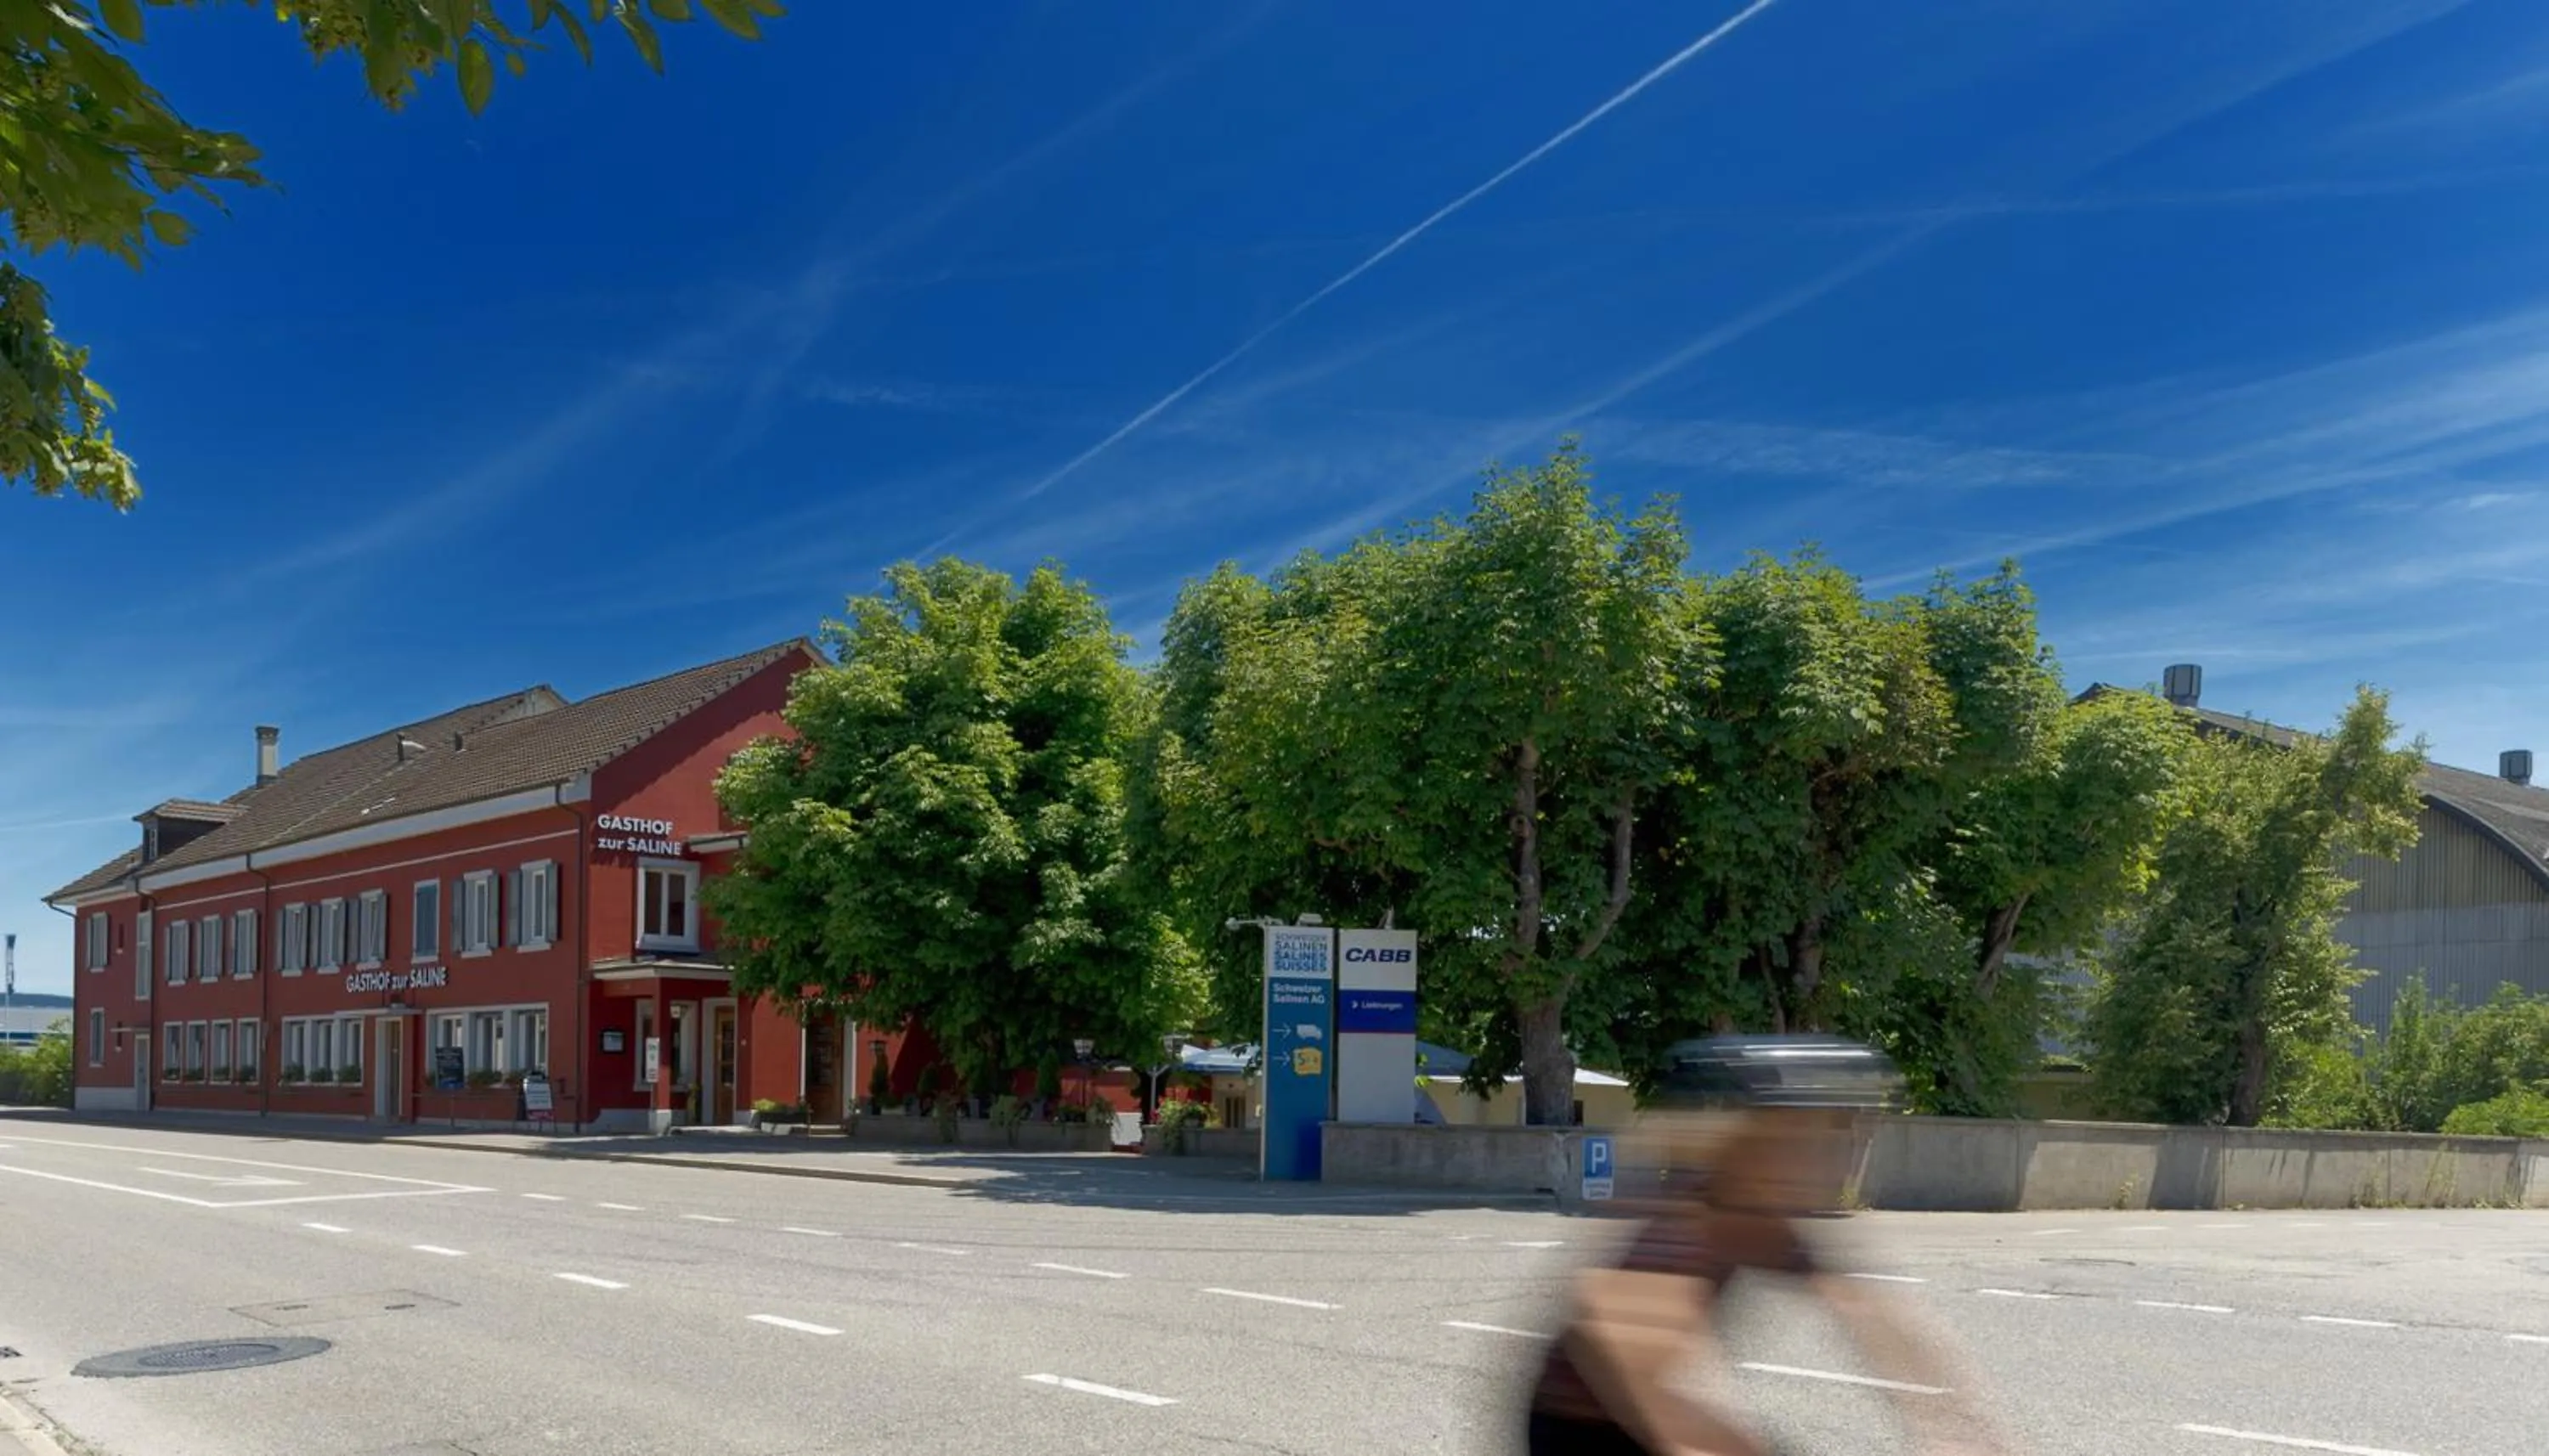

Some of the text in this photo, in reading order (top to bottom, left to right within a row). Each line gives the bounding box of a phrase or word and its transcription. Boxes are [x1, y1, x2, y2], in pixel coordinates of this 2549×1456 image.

[597, 814, 674, 835] GASTHOF
[597, 837, 681, 855] zur SALINE
[1345, 947, 1412, 962] CABB
[346, 967, 447, 993] GASTHOF zur SALINE
[1311, 994, 1325, 1004] AG
[1591, 1143, 1607, 1174] P
